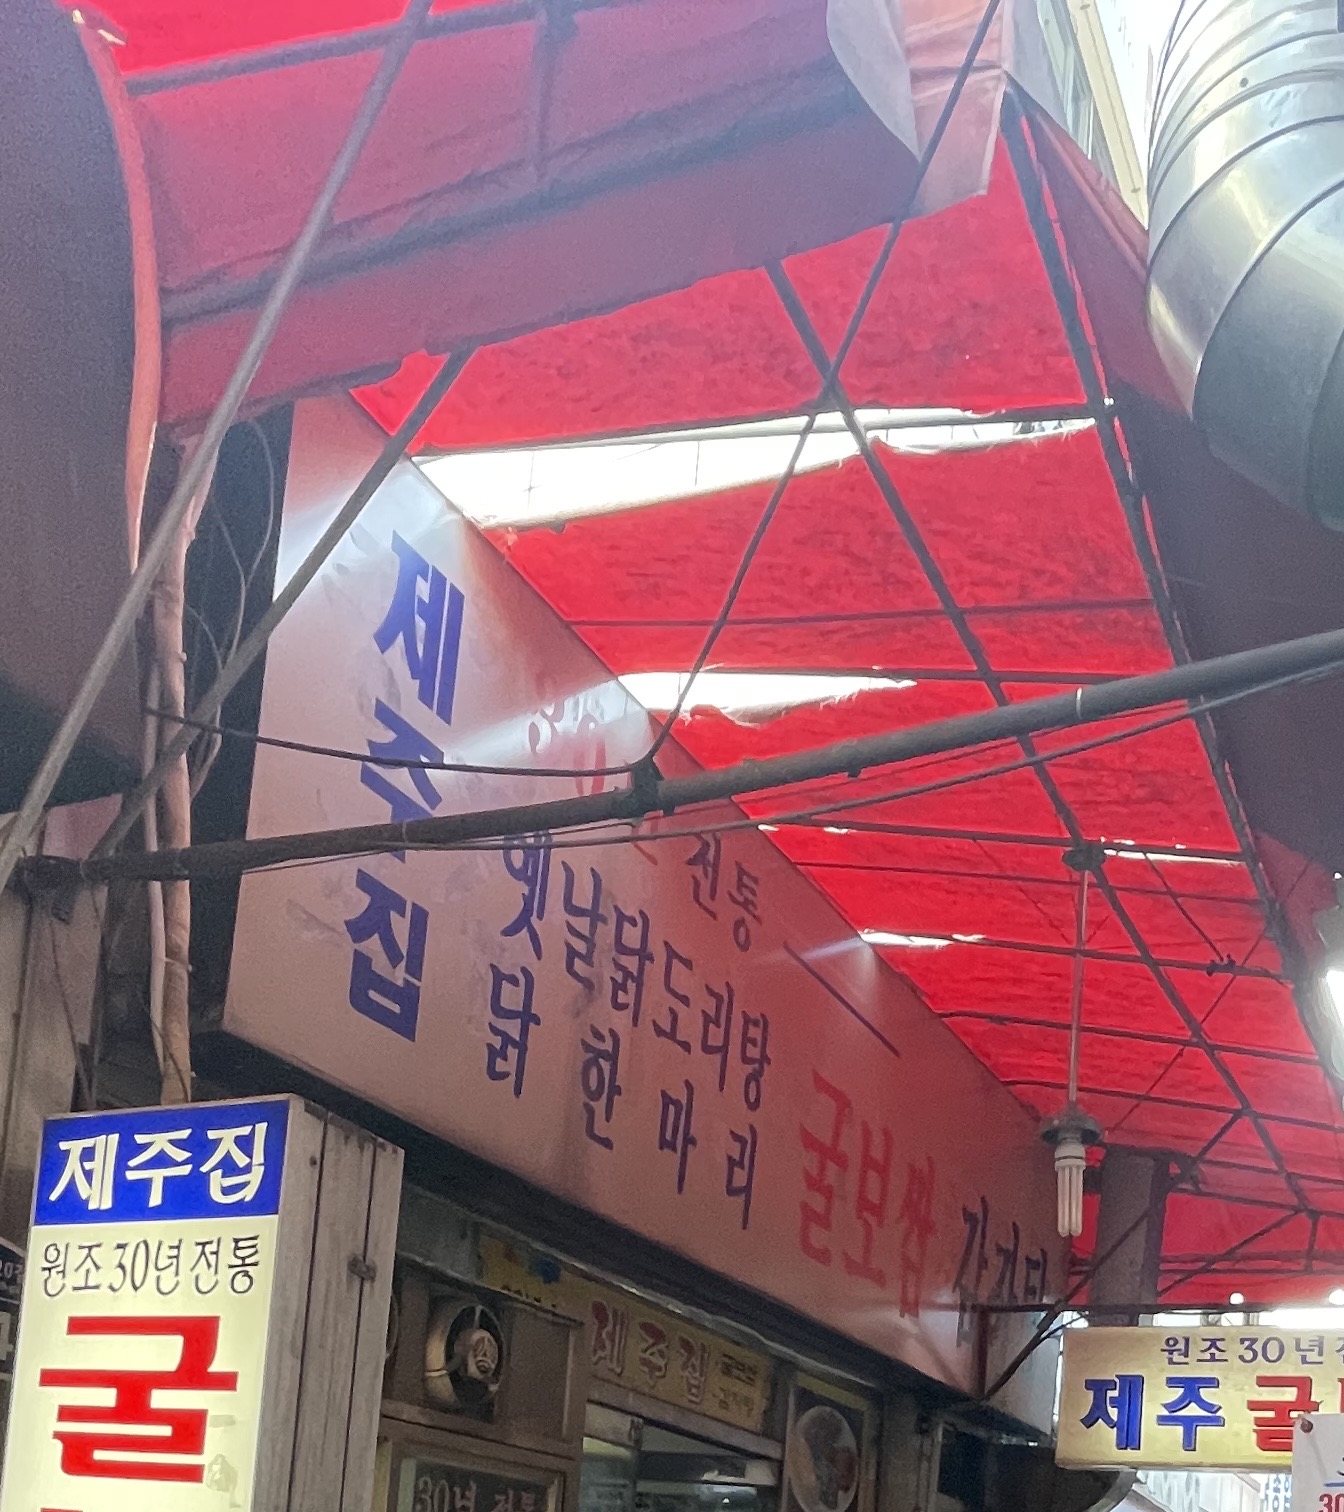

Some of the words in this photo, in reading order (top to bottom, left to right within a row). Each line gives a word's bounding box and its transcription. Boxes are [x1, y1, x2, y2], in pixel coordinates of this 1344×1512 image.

[343, 529, 465, 1041] 제주집
[48, 1121, 269, 1211] 제주집
[591, 1301, 712, 1405] 제주집
